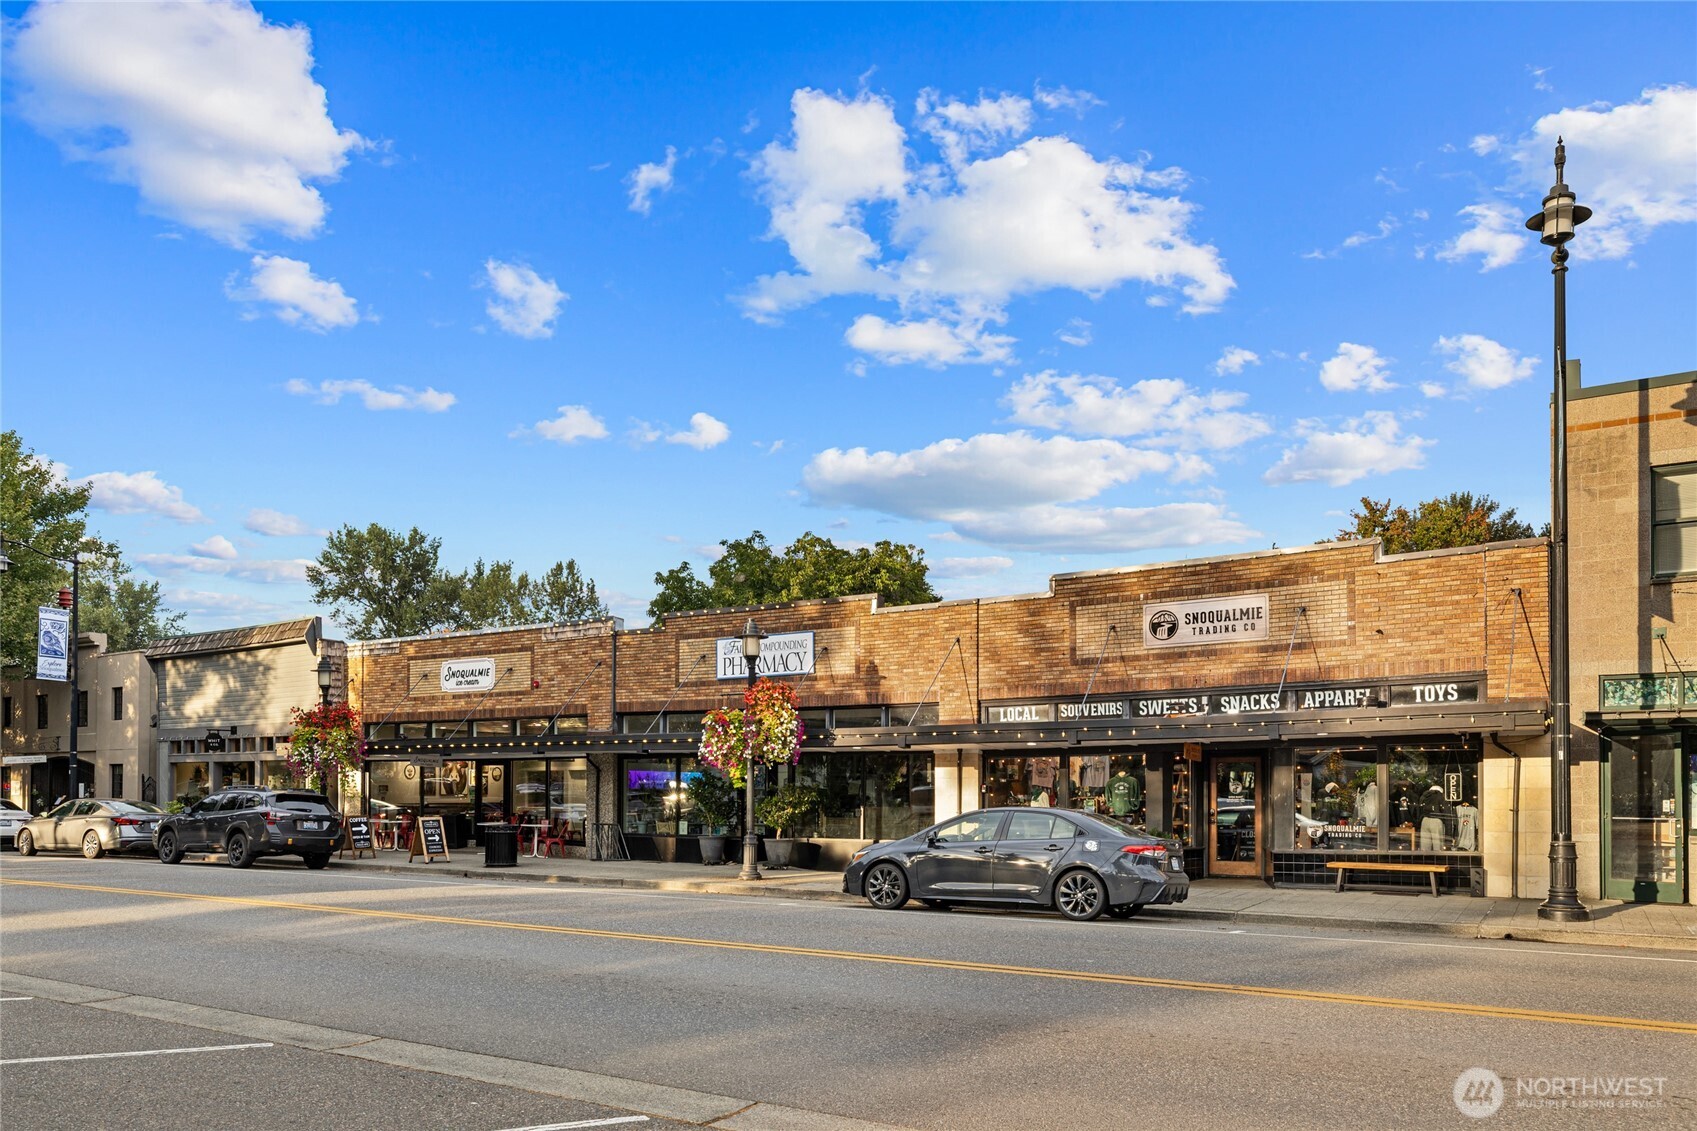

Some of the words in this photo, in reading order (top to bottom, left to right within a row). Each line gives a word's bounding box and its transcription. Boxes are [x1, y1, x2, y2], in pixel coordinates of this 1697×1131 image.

[1184, 606, 1263, 625] SNOQUALMIE
[1192, 624, 1237, 635] TRADING
[1243, 622, 1256, 631] CO
[760, 639, 808, 652] OMPOUNDING
[444, 666, 491, 682] SNOQUALMIE
[1413, 684, 1459, 703] TOYS
[1060, 701, 1123, 717] SOUVENIRS
[1220, 693, 1280, 712] SNACKS
[999, 707, 1039, 722] LOCAL
[1324, 825, 1366, 833] SNOQUALMIE
